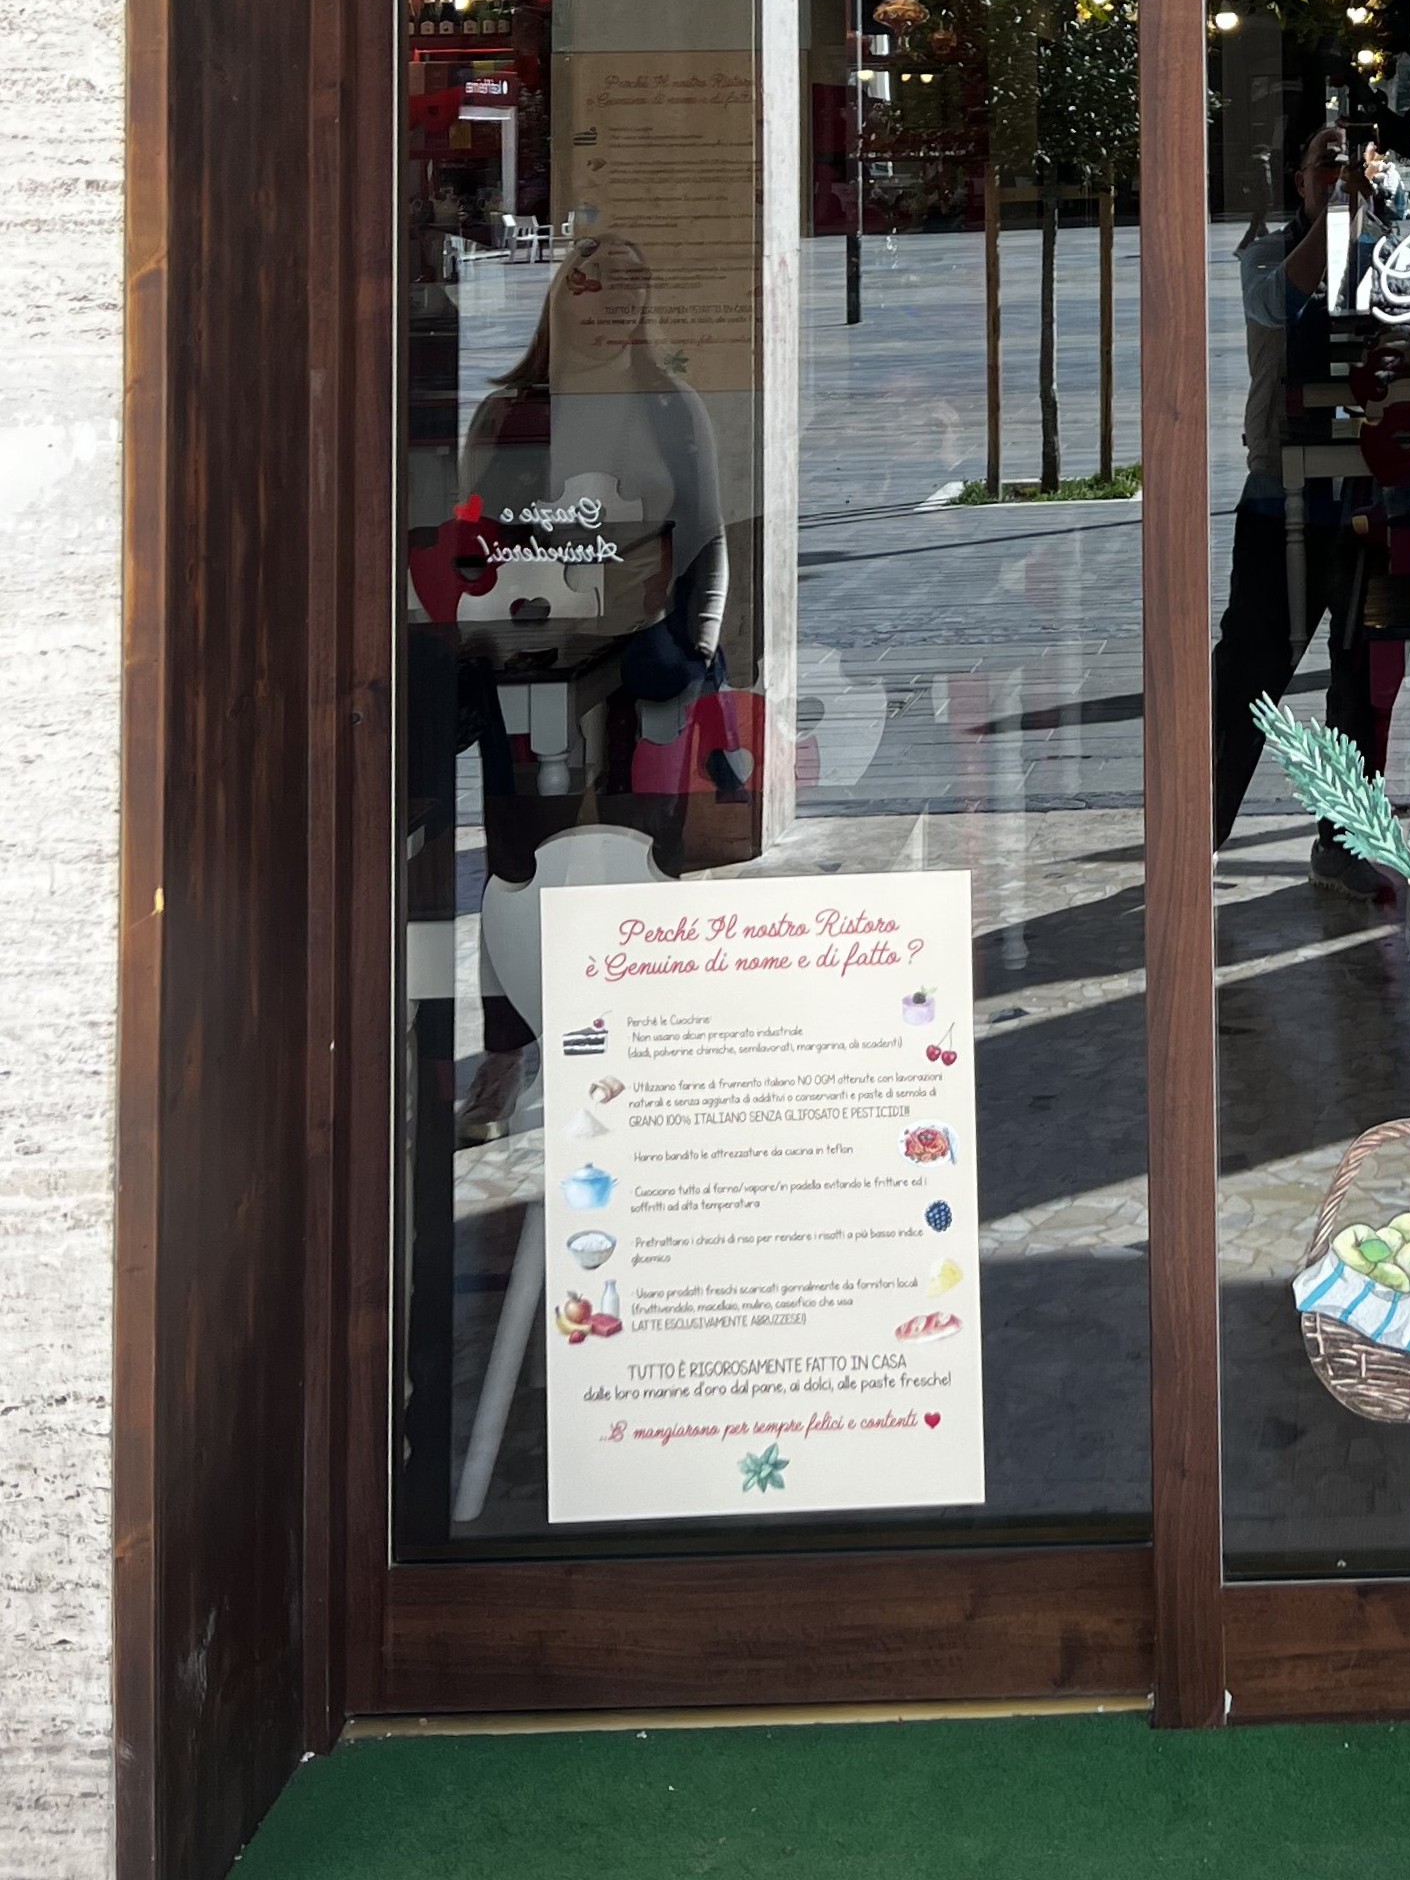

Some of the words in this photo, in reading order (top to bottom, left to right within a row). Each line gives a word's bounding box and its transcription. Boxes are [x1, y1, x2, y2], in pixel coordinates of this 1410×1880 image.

[619, 916, 700, 946] Perché
[705, 914, 738, 942] Il
[742, 913, 810, 938] nostro
[815, 909, 900, 937] Ristoro
[585, 956, 599, 977] è
[605, 952, 699, 982] Genuino
[705, 947, 729, 972] di
[735, 956, 792, 971] nome
[798, 955, 811, 968] e
[816, 943, 840, 968] di
[841, 941, 901, 977] fatto
[798, 1075, 812, 1086] NO
[629, 1114, 664, 1127] GRANO
[695, 1111, 747, 1125] ITALIANO
[749, 1110, 782, 1122] SENZA
[628, 1363, 675, 1381] TUTTO
[689, 1357, 802, 1378] RIGOROSAMENTE
[806, 1356, 847, 1373] FATTO
[851, 1355, 868, 1371] IN
[872, 1354, 907, 1370] CASA
[584, 1386, 611, 1402] dalle
[615, 1385, 640, 1400] loro
[643, 1384, 690, 1399] manine
[730, 1379, 749, 1395] dal
[837, 1375, 857, 1390] alle
[861, 1373, 896, 1393] paste
[804, 1411, 844, 1439] felici
[860, 1408, 918, 1430] contenti
